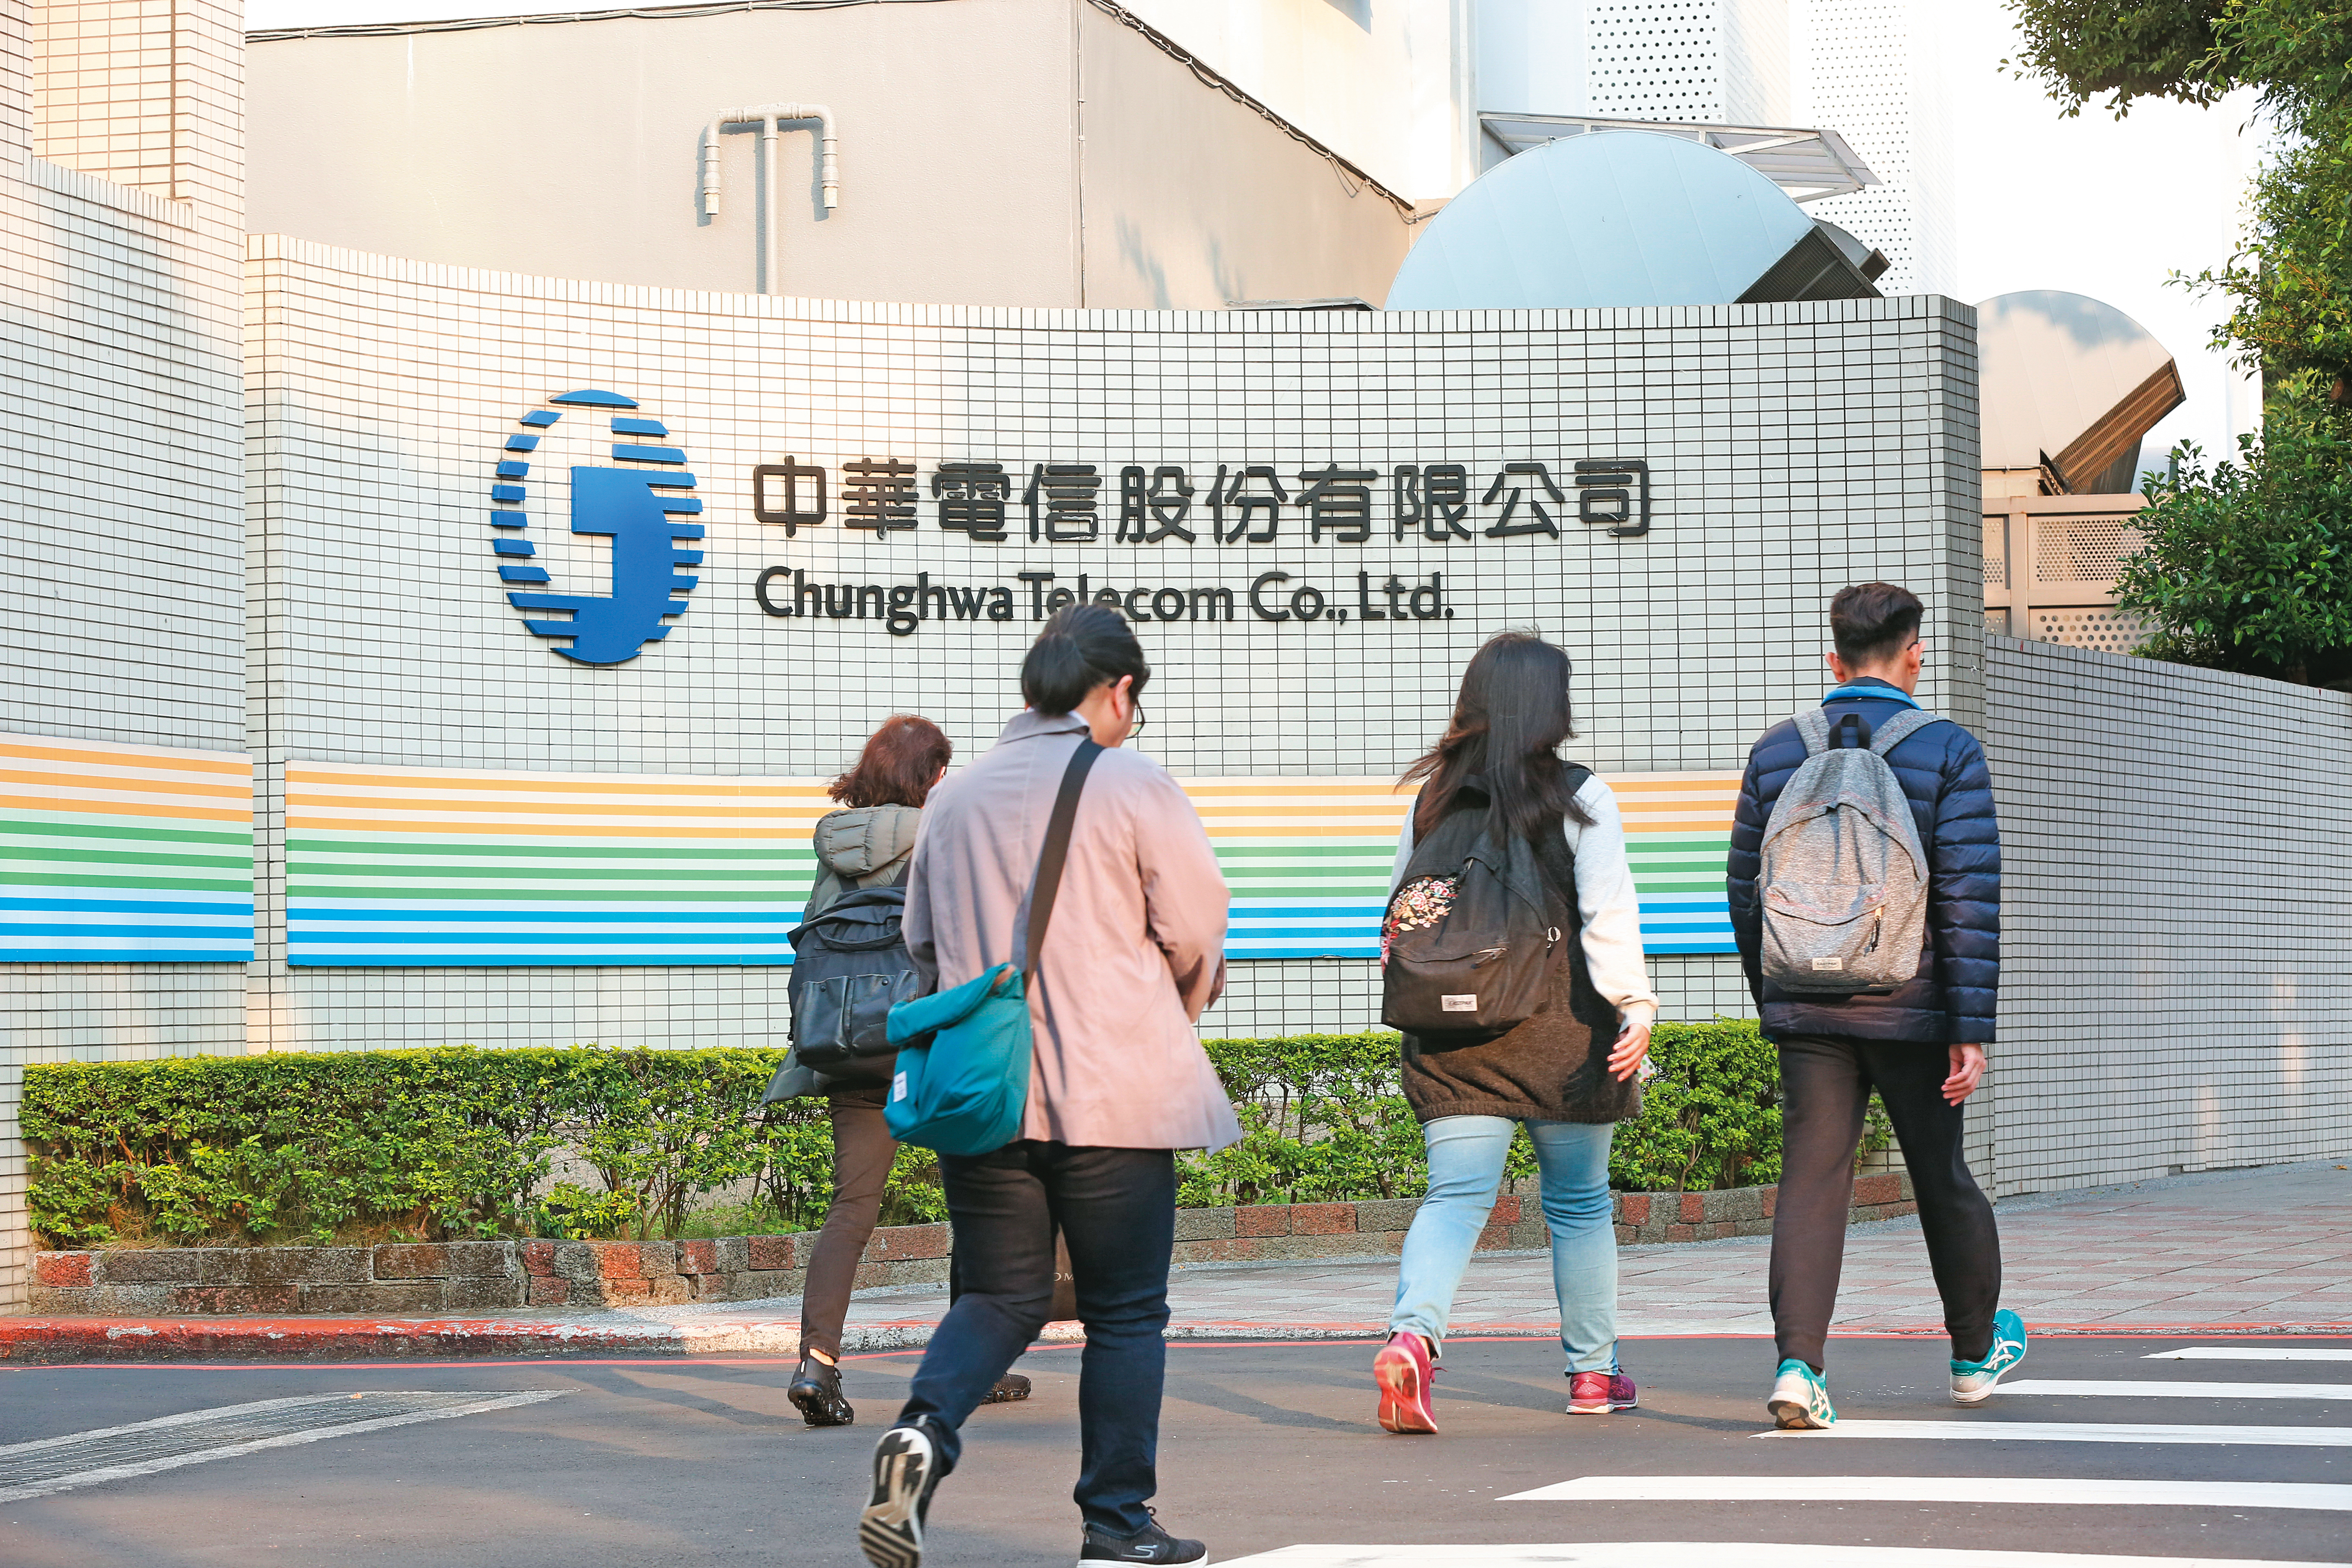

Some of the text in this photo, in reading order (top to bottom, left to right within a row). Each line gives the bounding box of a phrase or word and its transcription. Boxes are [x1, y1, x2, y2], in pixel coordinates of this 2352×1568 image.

[754, 456, 1650, 542] 中華電信股份有限公司
[756, 566, 1014, 635] Chunghwa
